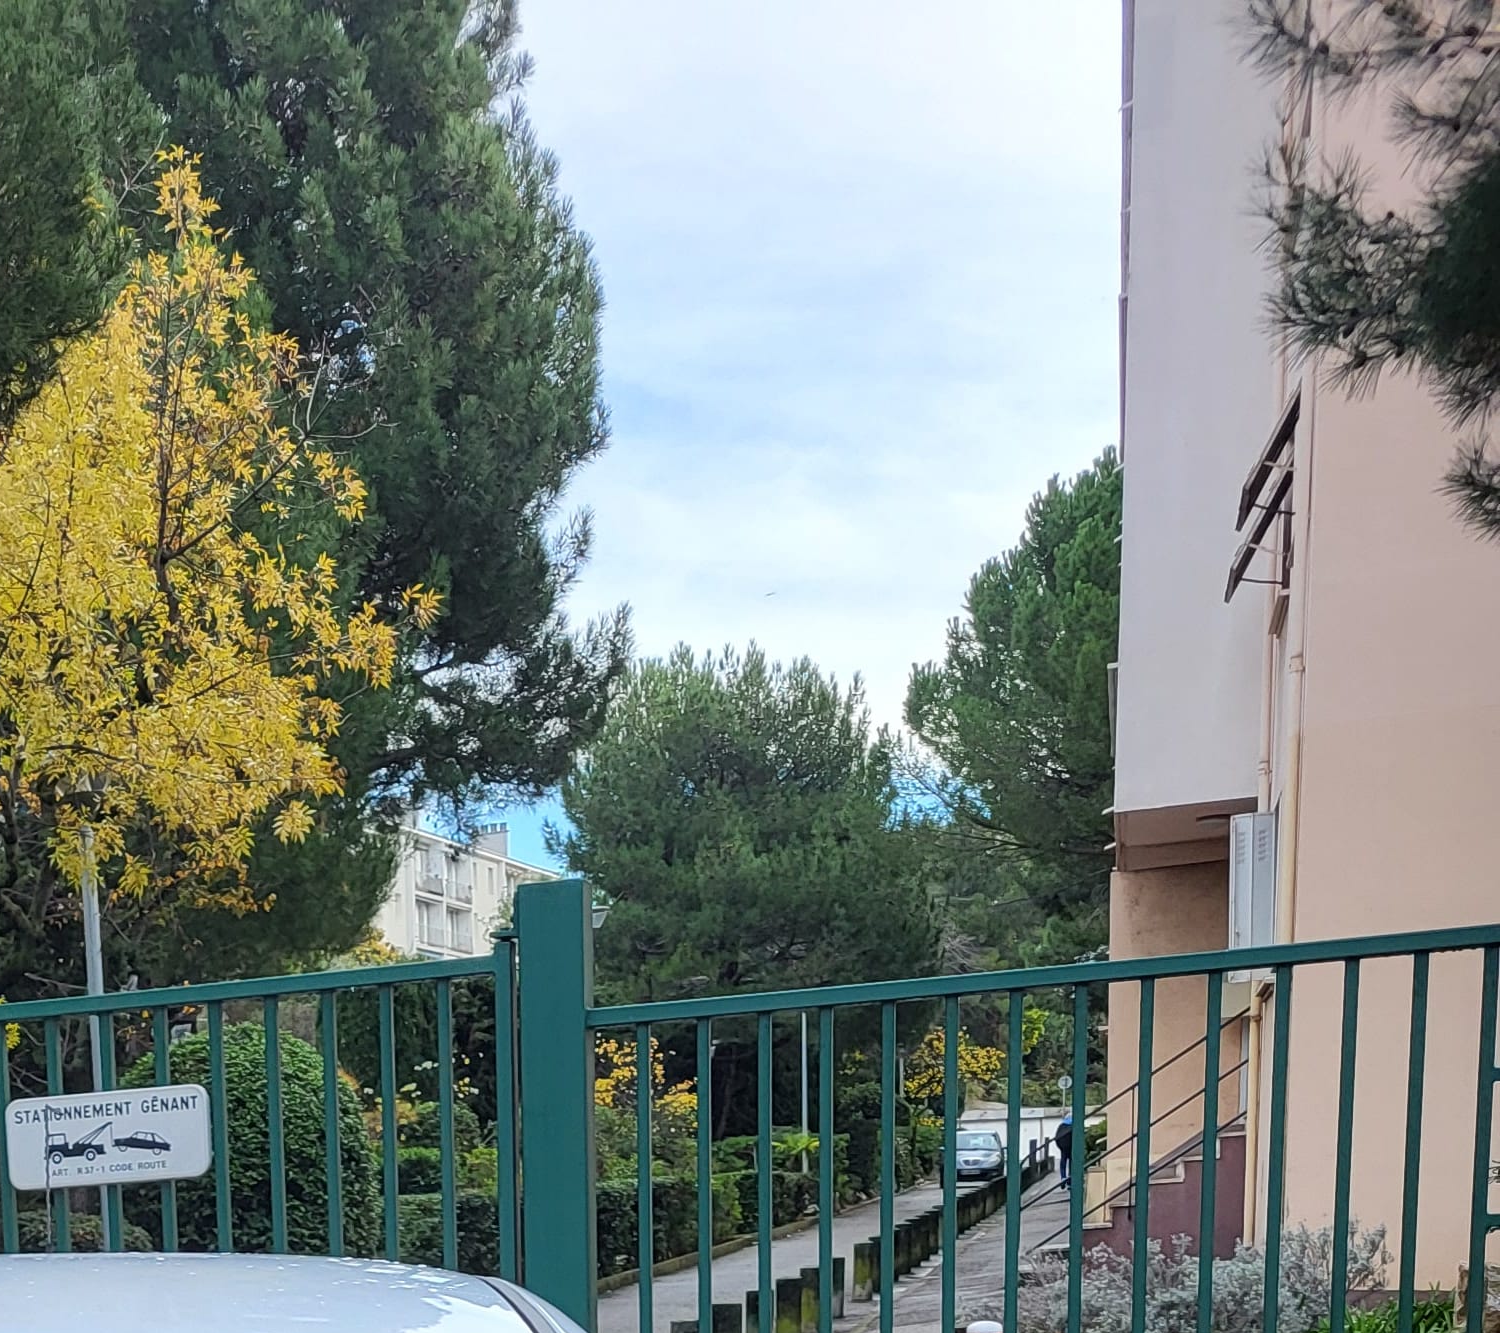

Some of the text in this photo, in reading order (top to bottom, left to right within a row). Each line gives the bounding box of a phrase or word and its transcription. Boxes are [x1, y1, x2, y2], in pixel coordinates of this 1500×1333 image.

[14, 1095, 198, 1124] STATIONNEMENT GÊNANT
[109, 1162, 132, 1172] CODE
[137, 1159, 167, 1169] ROUTE
